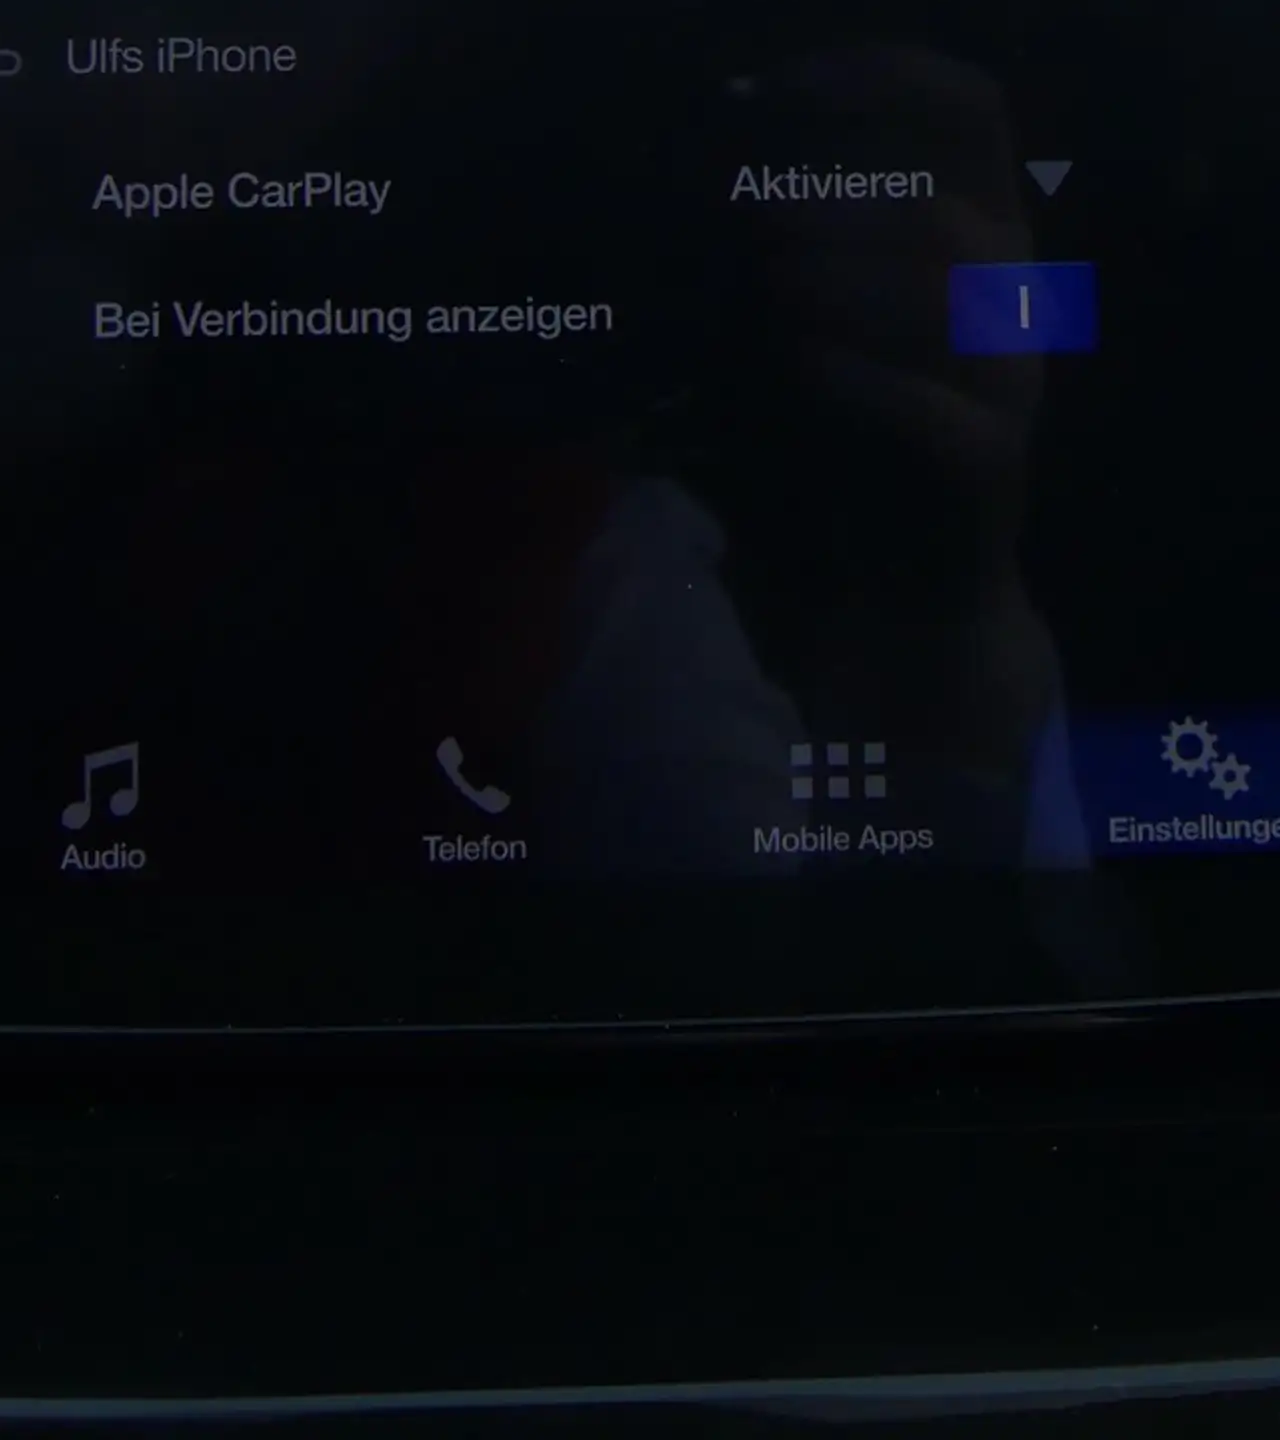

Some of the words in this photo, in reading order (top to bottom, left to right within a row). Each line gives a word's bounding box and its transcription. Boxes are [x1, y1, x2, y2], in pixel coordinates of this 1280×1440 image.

[66, 37, 145, 75] Ulfs
[157, 37, 298, 74] iPhone
[91, 173, 214, 219] Apple
[227, 171, 392, 216] CarPlay
[729, 163, 934, 202] Aktivieren
[94, 300, 160, 339] Bei
[172, 297, 413, 344] Verbindung
[426, 296, 614, 341] anzeigen
[60, 841, 147, 871] Audio
[422, 833, 528, 863] Telefon
[752, 825, 851, 855] Mobile
[857, 823, 935, 857] Apps
